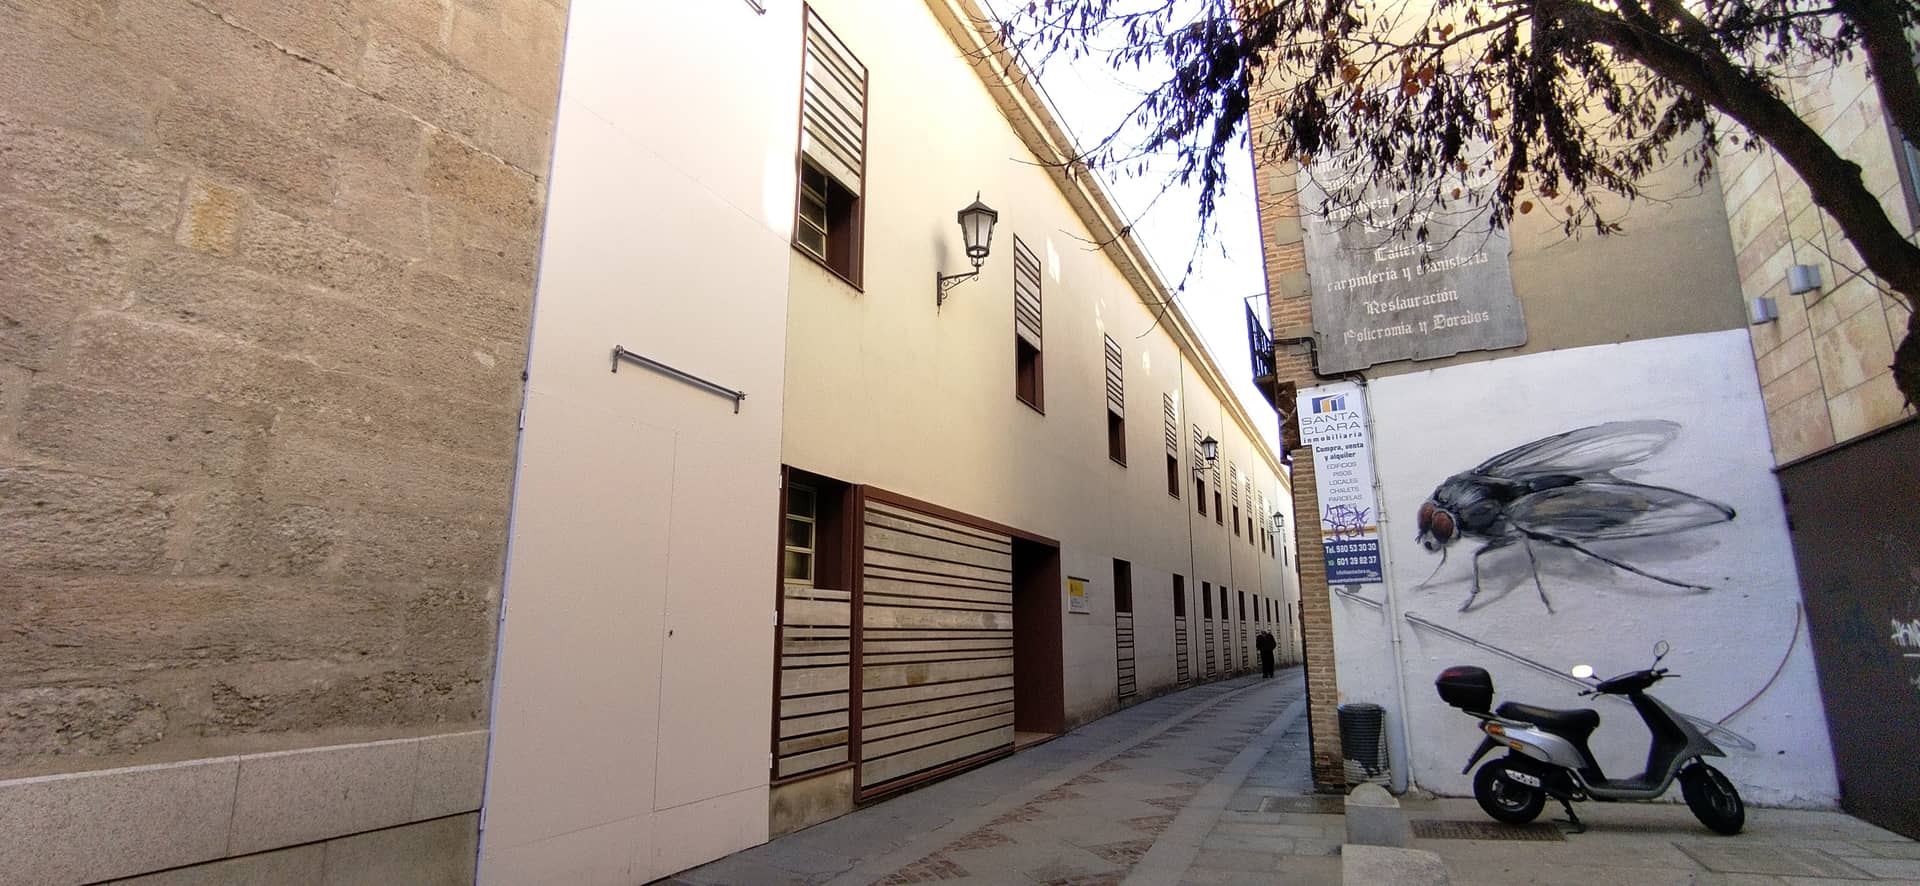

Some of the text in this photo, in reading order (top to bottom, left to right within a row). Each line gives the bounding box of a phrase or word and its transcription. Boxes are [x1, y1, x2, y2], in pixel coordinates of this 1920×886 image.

[1374, 243, 1432, 262] Talleres
[1402, 266, 1411, 281] y
[1419, 320, 1428, 335] y
[1432, 309, 1489, 331] Dorados
[1302, 411, 1359, 426] SANTA
[1302, 421, 1360, 436] CLARA
[1303, 432, 1362, 443] inmobiliaria
[1315, 442, 1364, 453] Compra, venta
[1330, 452, 1356, 460] alquiler
[1329, 486, 1359, 494] CHALETS
